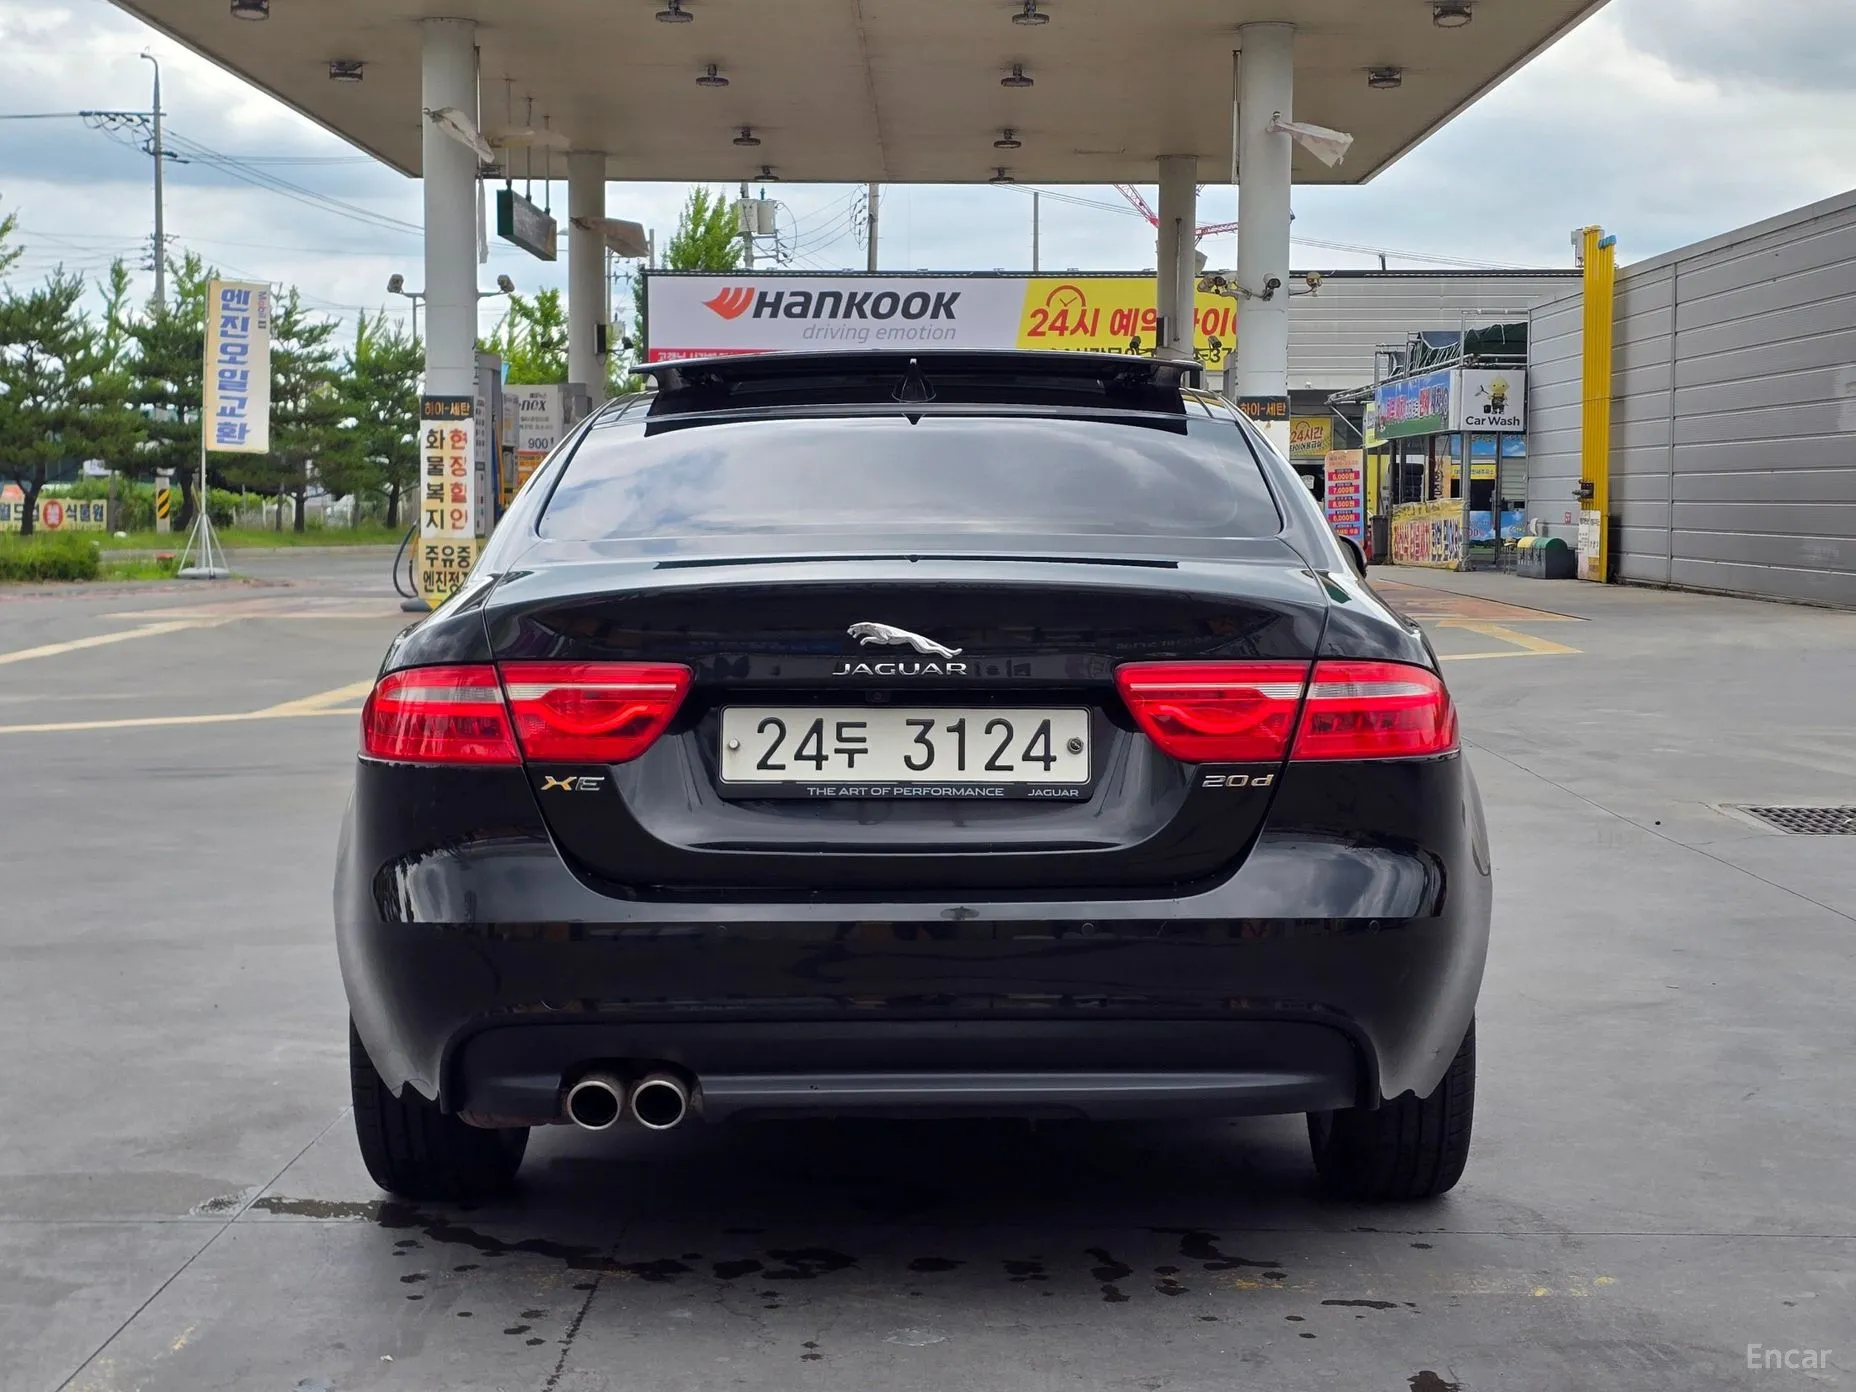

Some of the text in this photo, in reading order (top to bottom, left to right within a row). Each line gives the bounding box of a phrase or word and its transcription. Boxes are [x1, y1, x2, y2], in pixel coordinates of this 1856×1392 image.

[1027, 307, 1100, 337] 24시
[802, 324, 957, 344] driving emotion
[1465, 416, 1521, 426] Car Wash
[1290, 426, 1323, 443] 24시간
[425, 428, 446, 530] 화물복지
[425, 545, 471, 568] 주유중
[832, 662, 967, 676] JAGUAR
[756, 717, 1057, 772] 24두 3124
[540, 775, 605, 791] XE
[1201, 774, 1274, 788] 20d
[807, 787, 1004, 796] THE ART OF PERFORMANCE
[1027, 788, 1080, 797] JAGUAR
